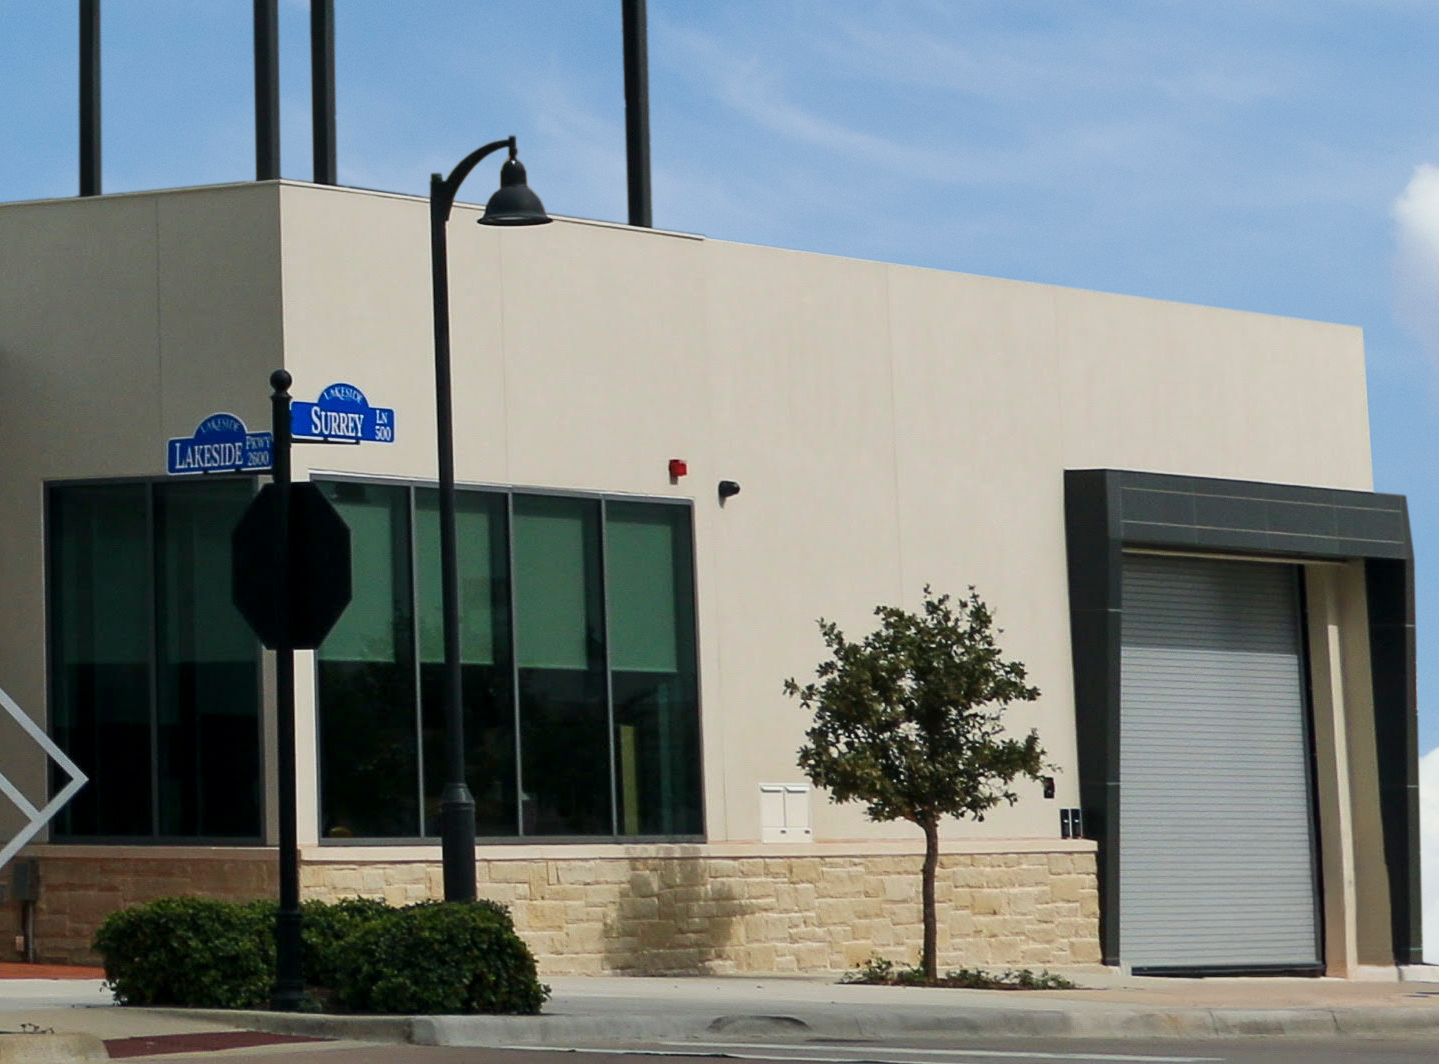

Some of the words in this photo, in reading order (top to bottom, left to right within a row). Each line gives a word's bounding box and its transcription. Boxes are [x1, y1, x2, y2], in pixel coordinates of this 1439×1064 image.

[323, 386, 362, 404] LAKESIDE
[311, 406, 364, 437] SURREY
[376, 409, 388, 424] LN
[201, 417, 240, 434] LAKESIDE
[374, 425, 392, 441] 500
[174, 442, 244, 469] LAKESIDE
[247, 451, 269, 466] 2600
